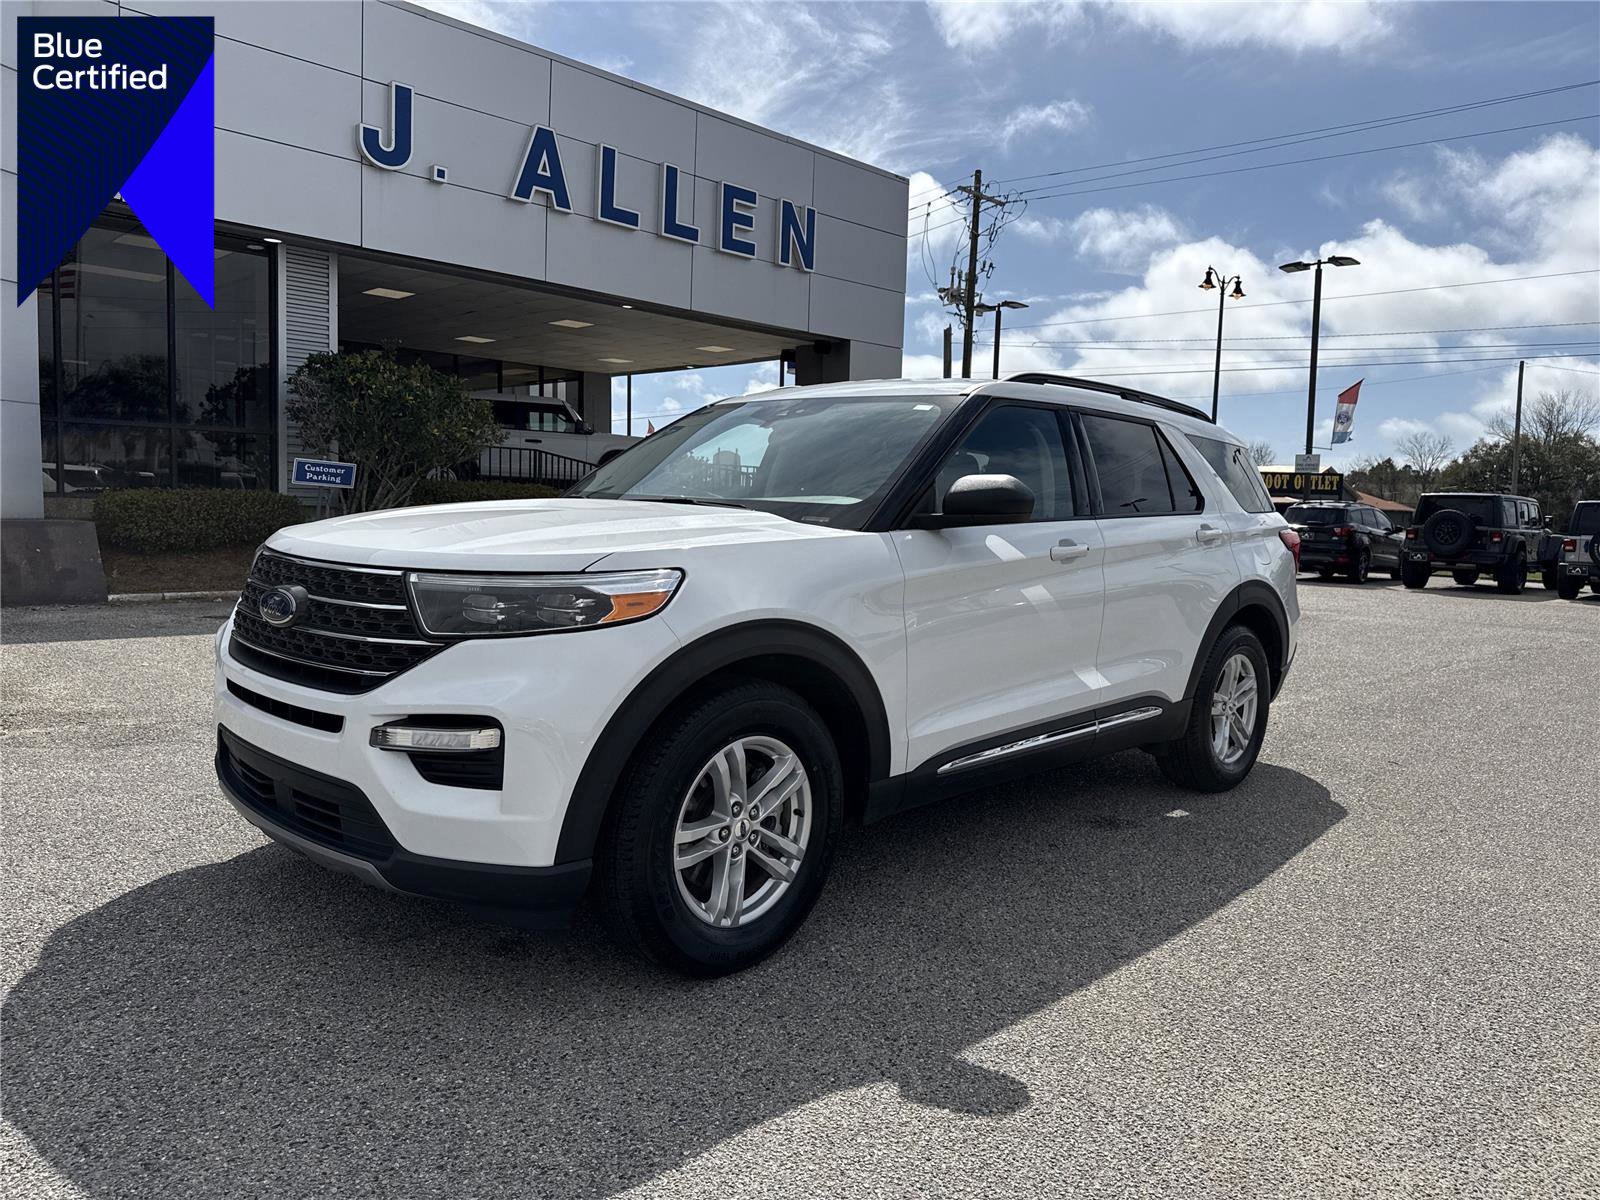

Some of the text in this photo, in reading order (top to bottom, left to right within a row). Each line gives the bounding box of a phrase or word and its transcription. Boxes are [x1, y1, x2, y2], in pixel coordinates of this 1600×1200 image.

[356, 81, 817, 272] J. ALLEN
[304, 463, 346, 474] Customer
[306, 472, 341, 483] Parking
[1263, 474, 1340, 490] OOT OTLET
